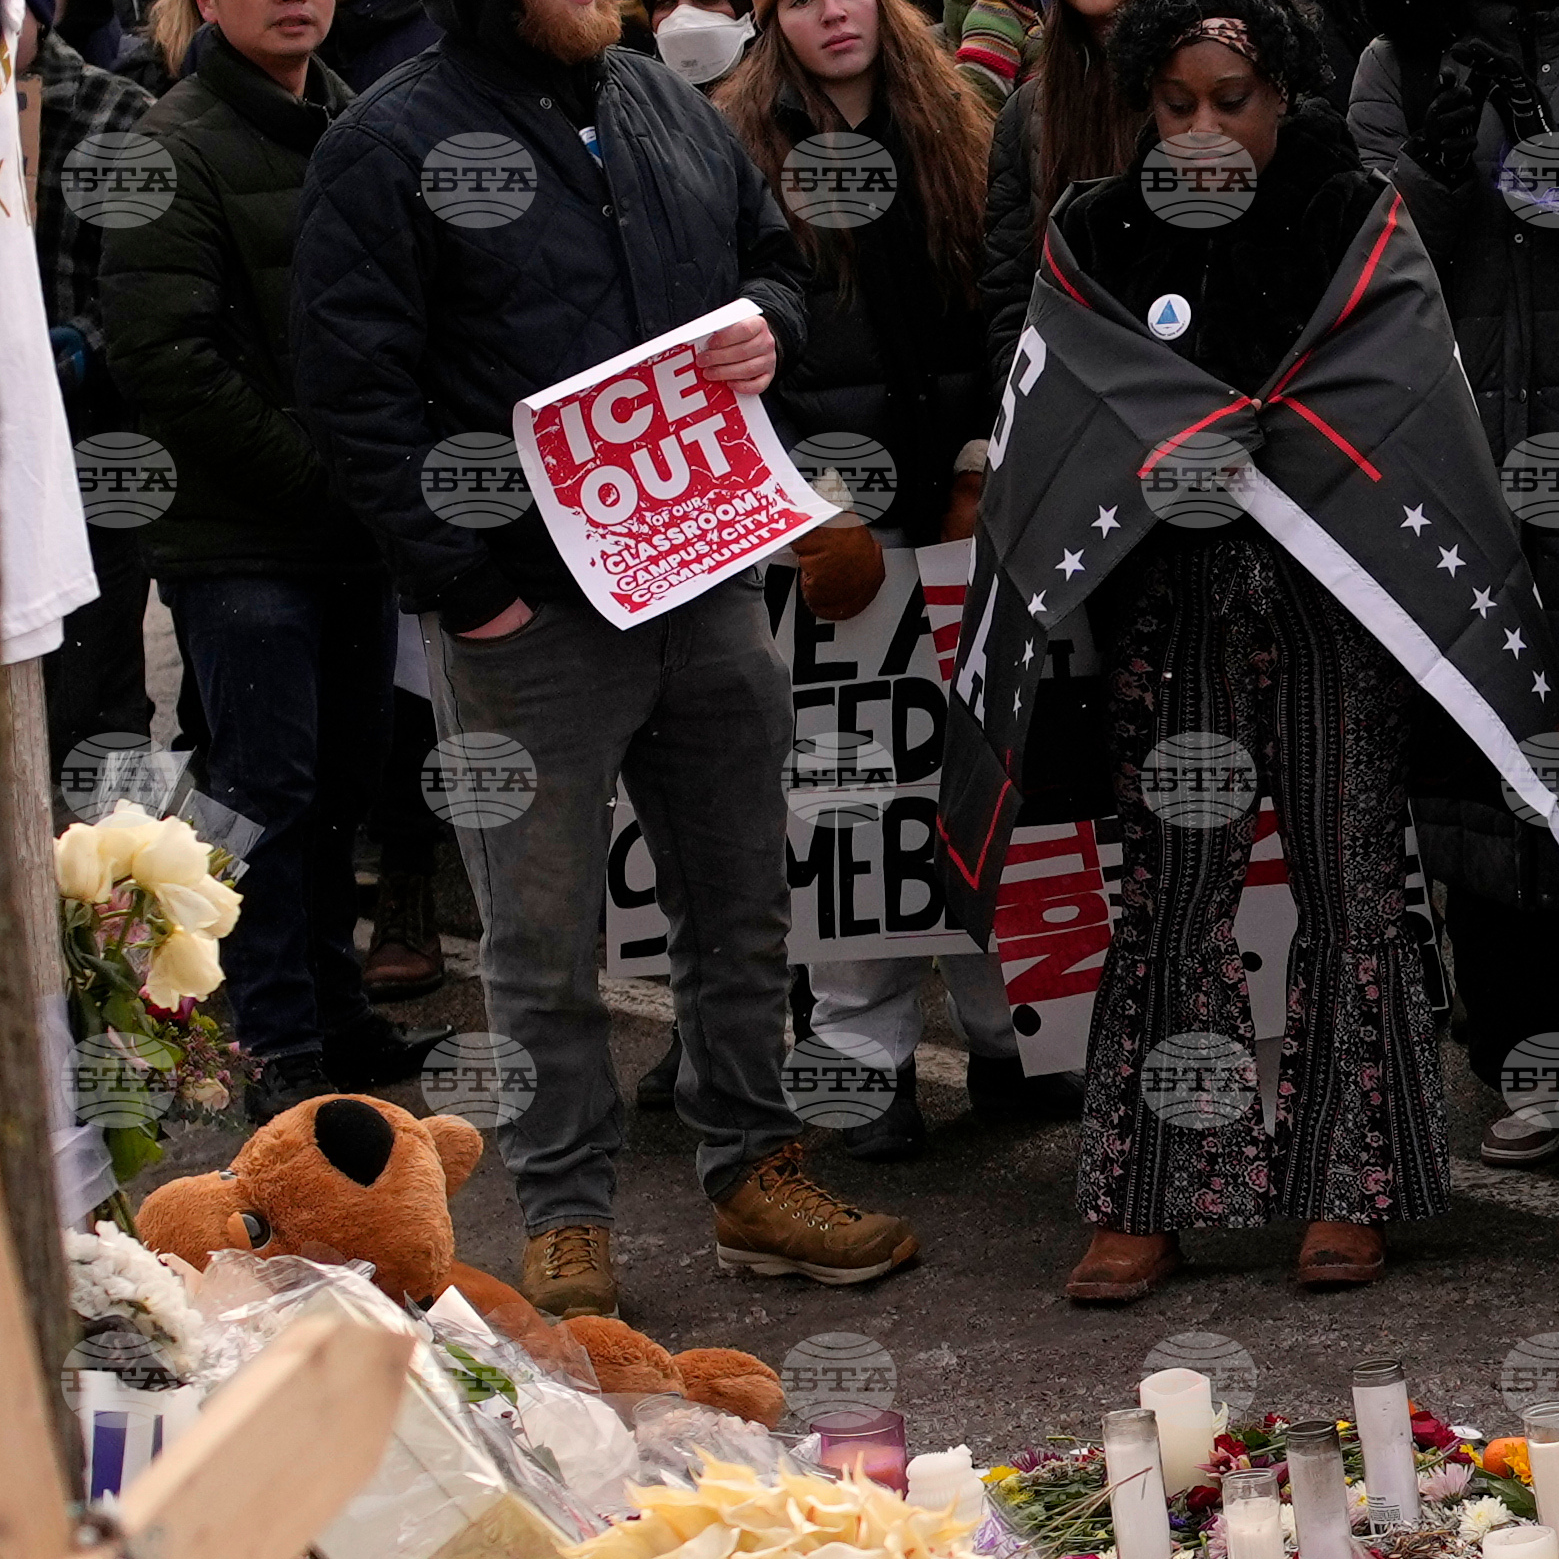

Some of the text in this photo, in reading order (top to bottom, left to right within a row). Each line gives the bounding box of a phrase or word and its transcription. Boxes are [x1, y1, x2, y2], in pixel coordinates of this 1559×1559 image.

[559, 349, 708, 465] ICE
[580, 413, 732, 526] OUT
[652, 496, 703, 527] OF OUR
[631, 517, 787, 604] COMMUNITY
